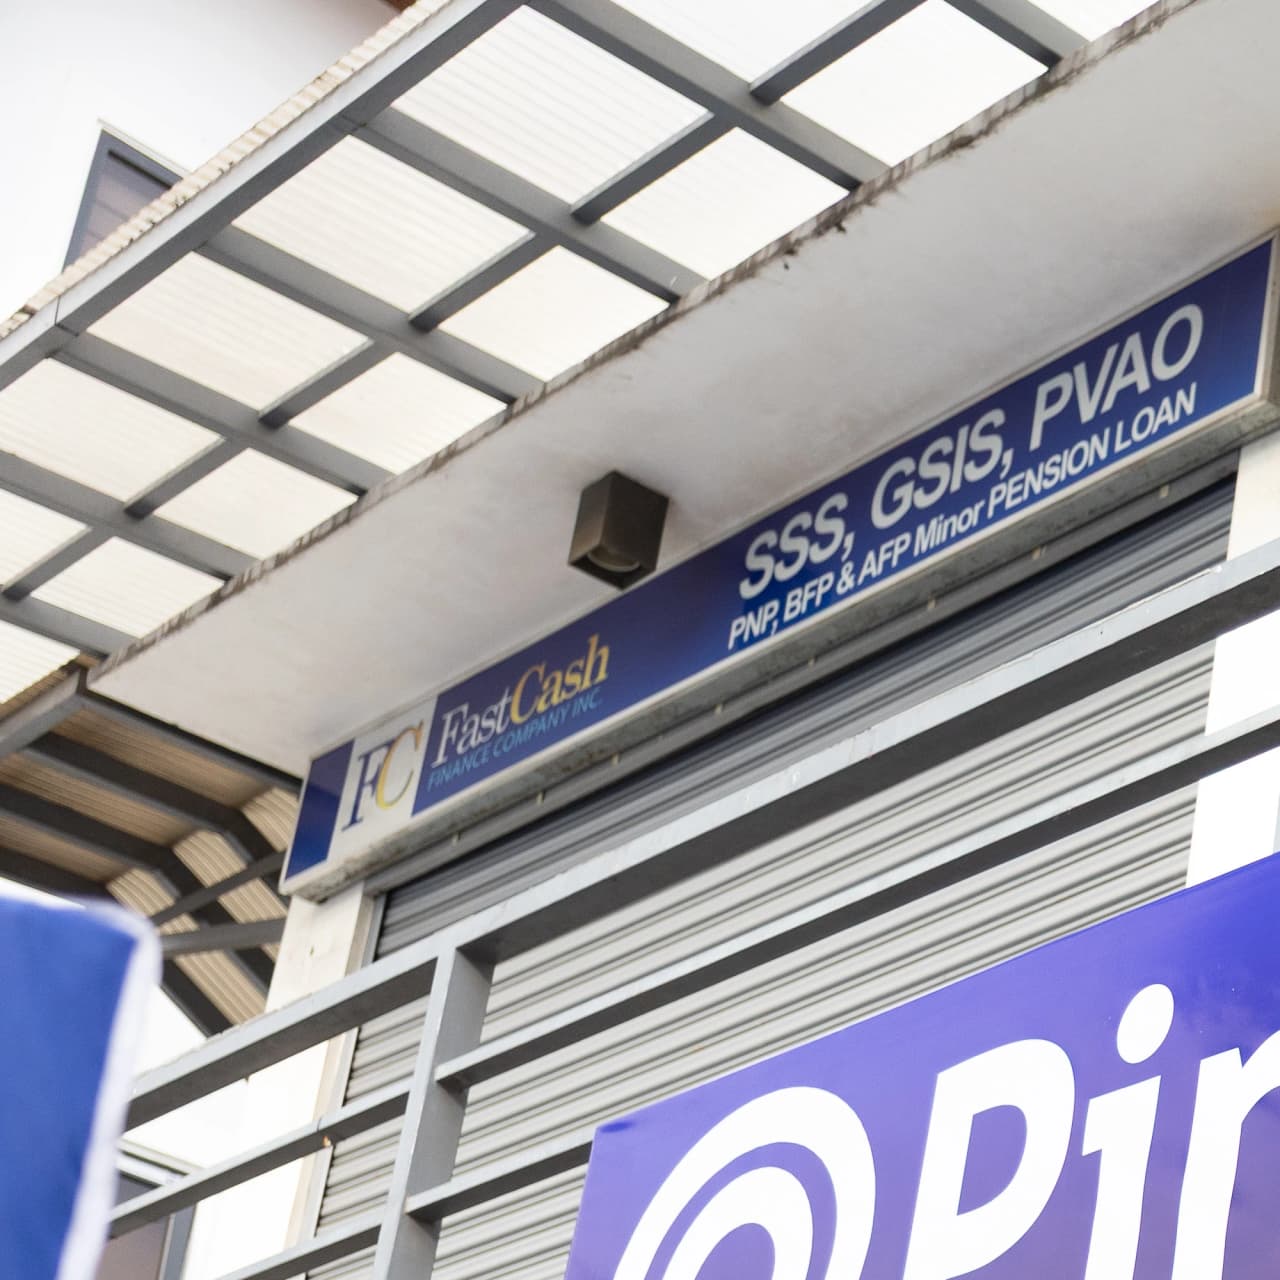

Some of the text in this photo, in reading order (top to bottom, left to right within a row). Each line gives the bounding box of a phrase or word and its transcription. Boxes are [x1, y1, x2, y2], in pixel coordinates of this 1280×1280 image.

[728, 381, 1197, 650] PNP, BFP & AFP Minor PENSION LOAN
[739, 303, 1204, 600] SSS, GSIS, PVAO
[427, 743, 490, 793] FINANCE
[493, 705, 568, 762] COMPANY
[431, 634, 609, 768] FastCash
[341, 720, 424, 832] FC
